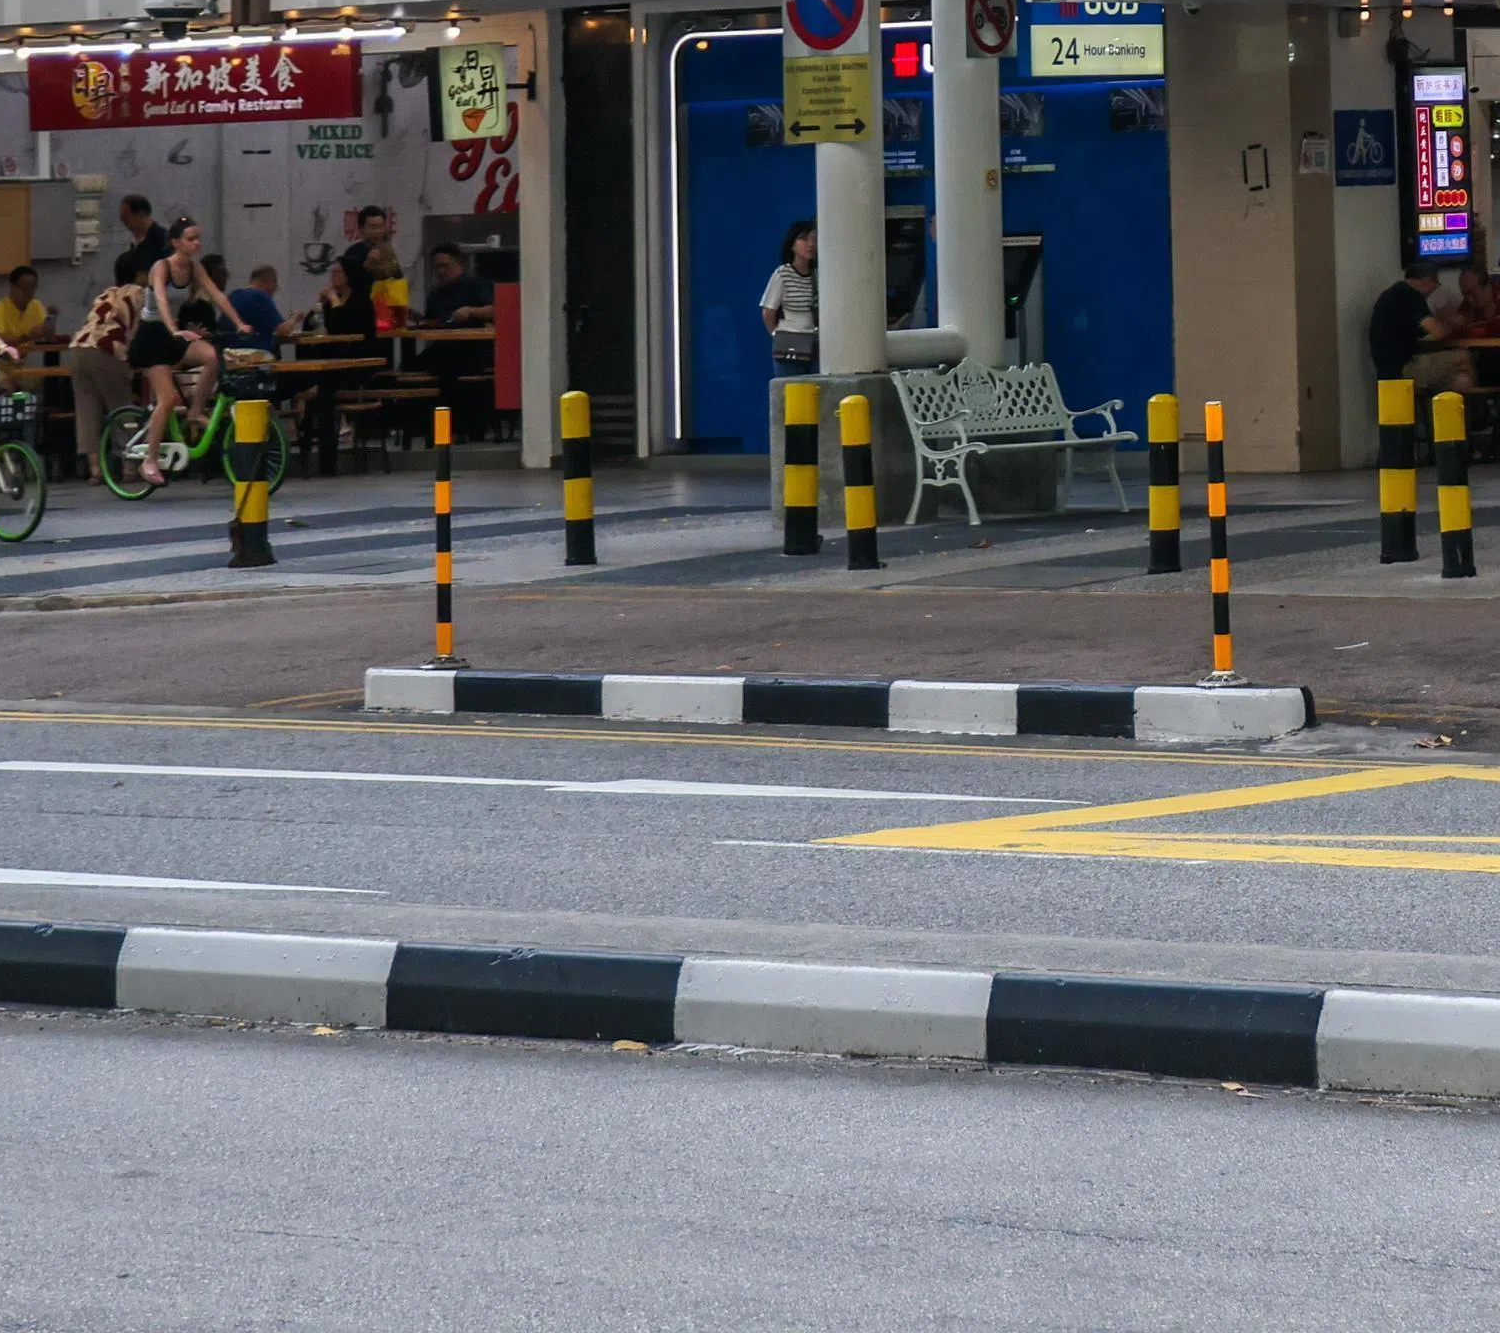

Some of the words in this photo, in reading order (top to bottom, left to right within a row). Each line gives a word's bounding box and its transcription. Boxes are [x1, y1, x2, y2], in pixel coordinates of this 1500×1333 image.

[1051, 36, 1080, 66] 24
[1083, 44, 1106, 57] Hour
[1108, 43, 1146, 59] Banking
[140, 52, 303, 98] 新加坡美食
[448, 79, 476, 100] Good
[197, 100, 235, 115] Family
[238, 97, 303, 112] Restaurant
[308, 124, 363, 141] MIXED
[296, 144, 332, 159] VEG
[335, 143, 375, 159] RICE
